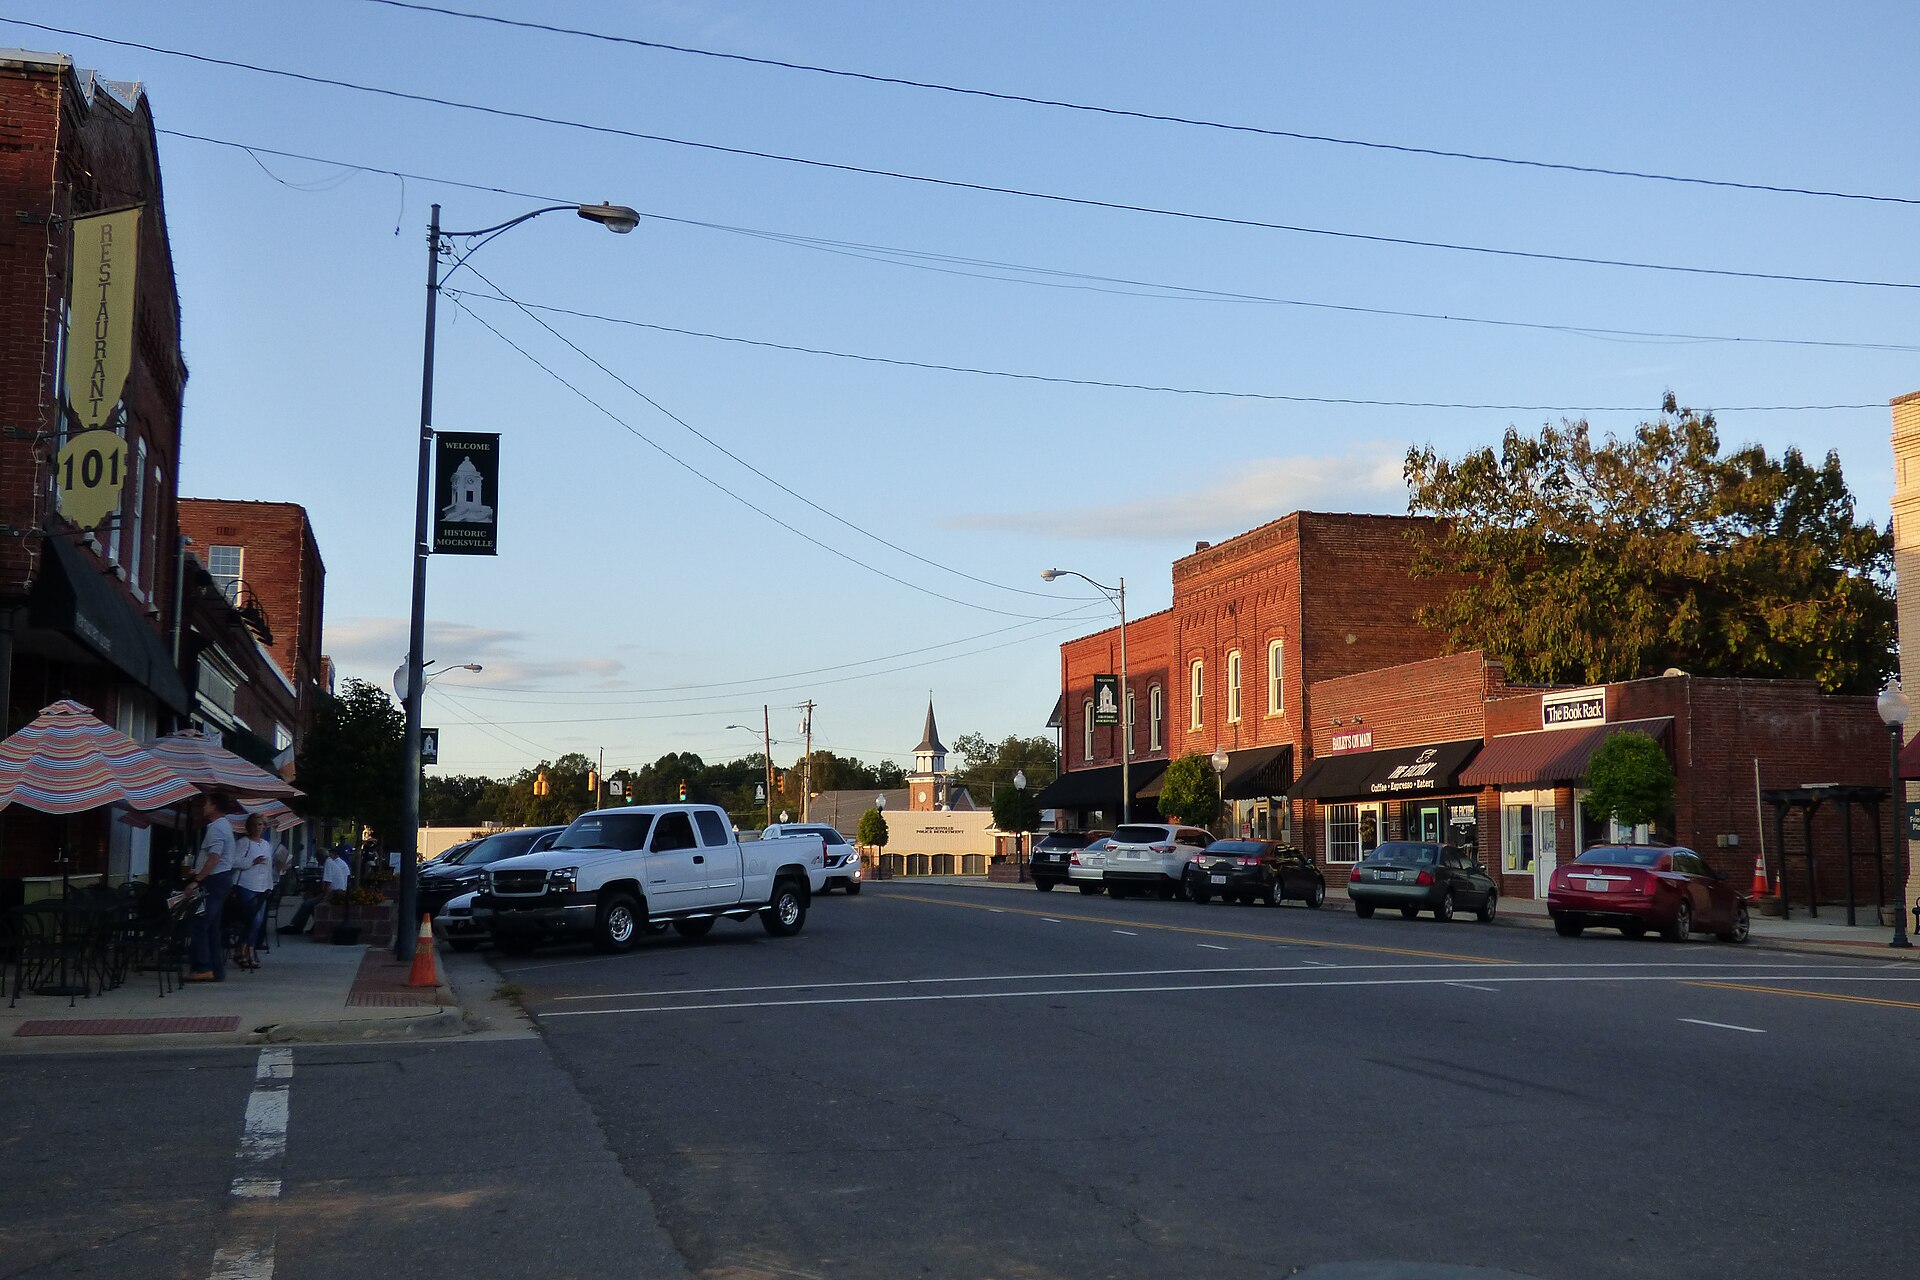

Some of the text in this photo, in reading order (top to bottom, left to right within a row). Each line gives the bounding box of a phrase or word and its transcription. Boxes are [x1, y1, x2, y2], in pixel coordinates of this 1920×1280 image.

[89, 223, 113, 419] RESTAURANT
[445, 442, 490, 451] WELCOME
[62, 446, 119, 490] 101
[443, 529, 487, 538] HISTORIC
[436, 538, 493, 547] MOCKSVILLE
[1547, 700, 1602, 721] The Book Rack
[1332, 732, 1372, 751] BAILEY'S ON MAIN
[1370, 779, 1435, 793] Coffee Espresso Eatery
